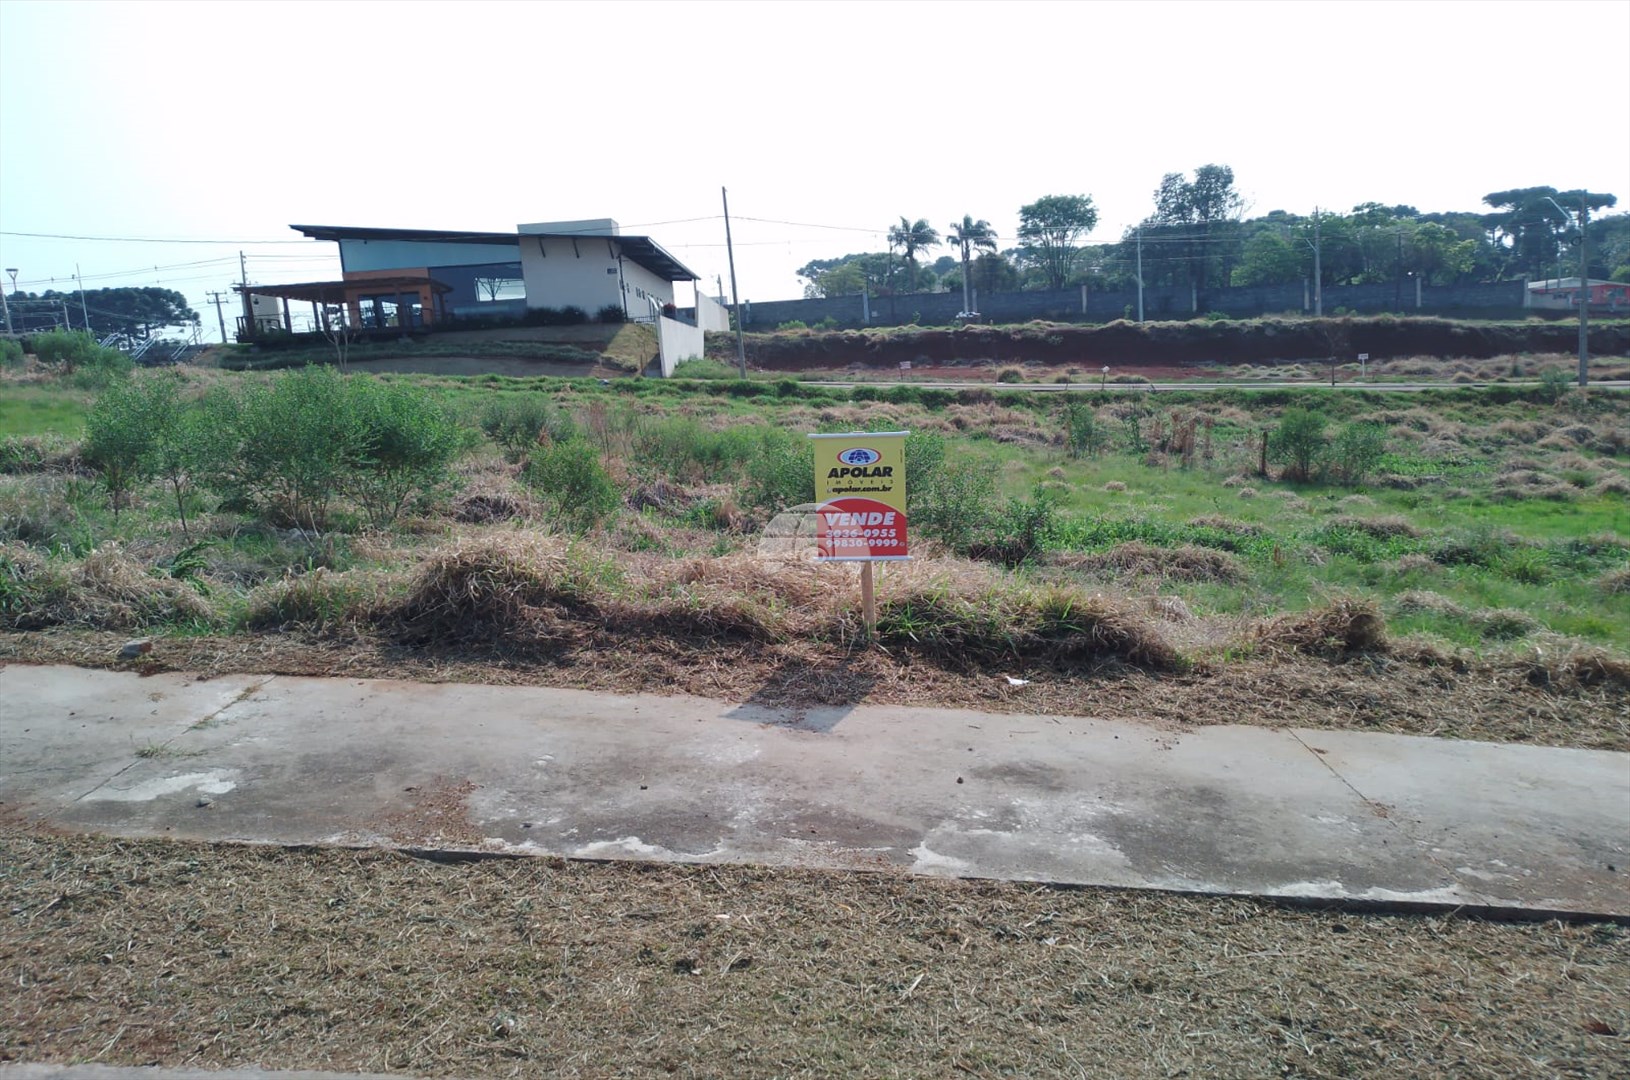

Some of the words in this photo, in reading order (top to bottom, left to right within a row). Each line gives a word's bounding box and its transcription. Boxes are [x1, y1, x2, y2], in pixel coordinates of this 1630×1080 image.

[828, 467, 892, 478] APOLAR
[832, 485, 892, 494] apolar.com.br
[824, 512, 895, 525] VENDE
[826, 529, 896, 538] 3036-0955
[825, 538, 898, 547] 99830-9999
